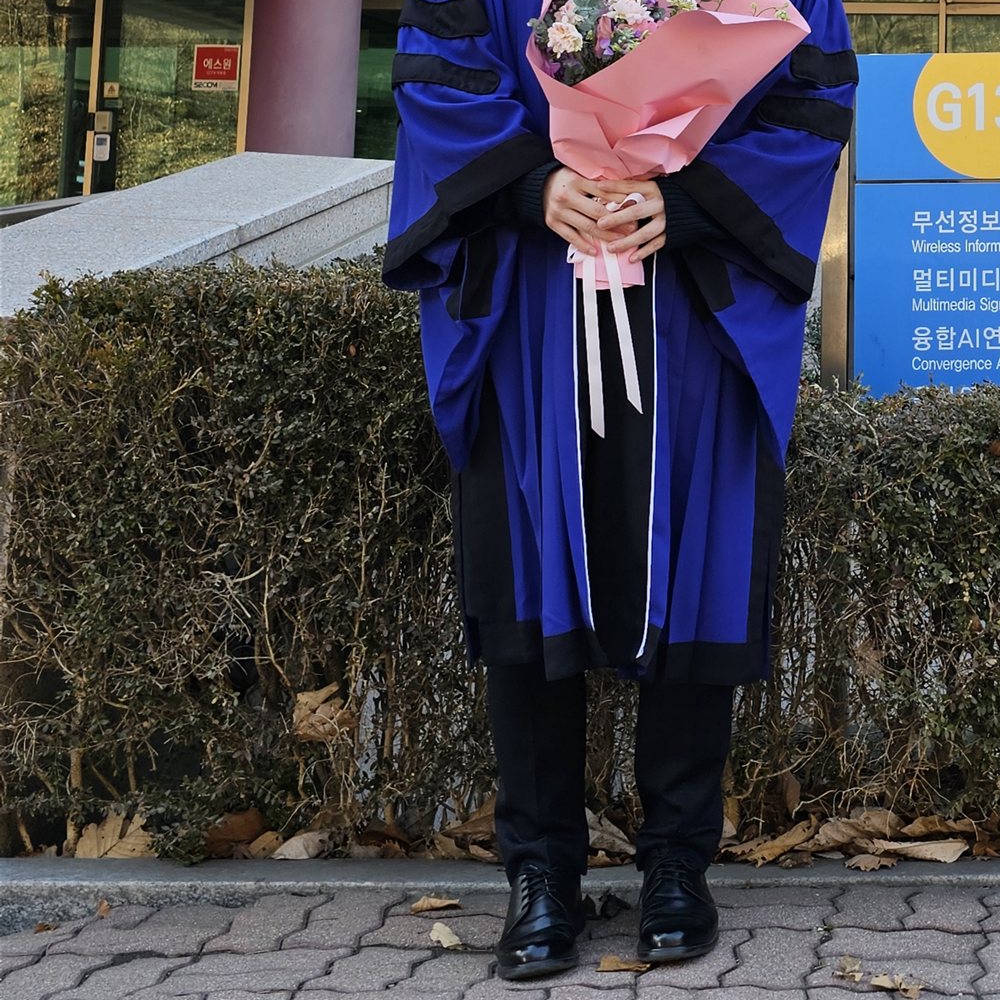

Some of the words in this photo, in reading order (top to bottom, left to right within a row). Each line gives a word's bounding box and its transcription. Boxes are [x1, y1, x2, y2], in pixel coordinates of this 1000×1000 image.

[203, 58, 232, 70] 에스원
[911, 239, 961, 253] Wireless
[912, 298, 976, 312] Multimedia
[911, 356, 993, 373] Convergence
